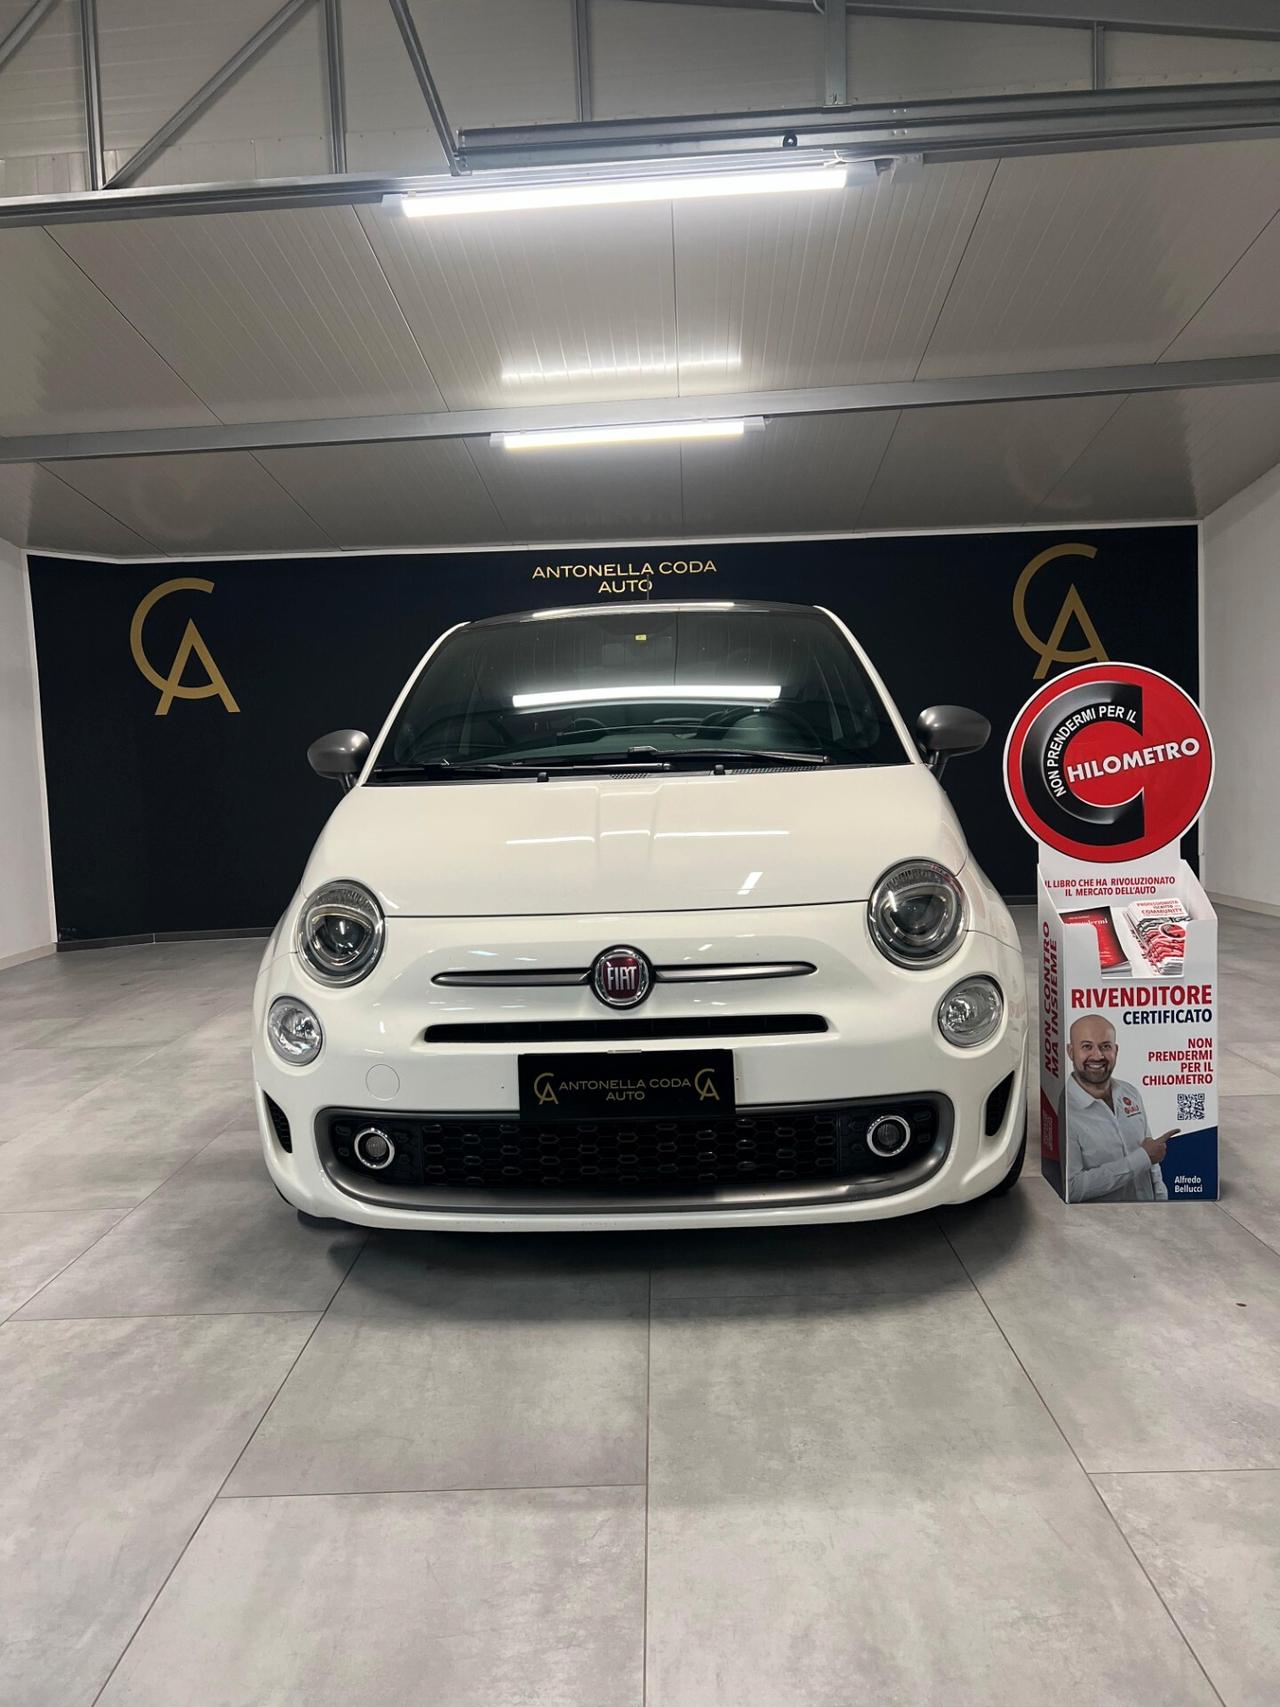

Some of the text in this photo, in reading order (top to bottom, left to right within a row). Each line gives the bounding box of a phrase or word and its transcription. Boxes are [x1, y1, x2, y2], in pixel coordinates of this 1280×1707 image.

[532, 560, 717, 579] ANTONELLA CODA
[598, 579, 653, 593] AUTO
[1047, 705, 1137, 797] NON PRENDERMI PER IL
[1053, 879, 1077, 888] LIBRO
[1078, 879, 1095, 887] CHE
[1096, 878, 1107, 887] HA
[1111, 876, 1176, 886] RIVOLUZIONATO
[1065, 886, 1156, 896] IL MERCATO DELL'AUTO
[607, 966, 637, 991] FIAT
[1042, 921, 1052, 1073] NON CONTRO
[1071, 984, 1212, 1008] RIVENDITORE
[1050, 939, 1059, 1079] MA INSIEME
[1123, 1008, 1212, 1025] CERTIFICATO
[1188, 1038, 1212, 1049] NON
[1148, 1050, 1213, 1062] PRENDERMI
[1180, 1062, 1214, 1073] PER IL
[559, 1077, 691, 1091] ANTONELLA CODA
[1142, 1074, 1213, 1086] CHILOMETRO
[606, 1091, 646, 1101] AUTO
[1174, 1175, 1202, 1184] Alfredo
[1174, 1184, 1203, 1193] Bellucci
